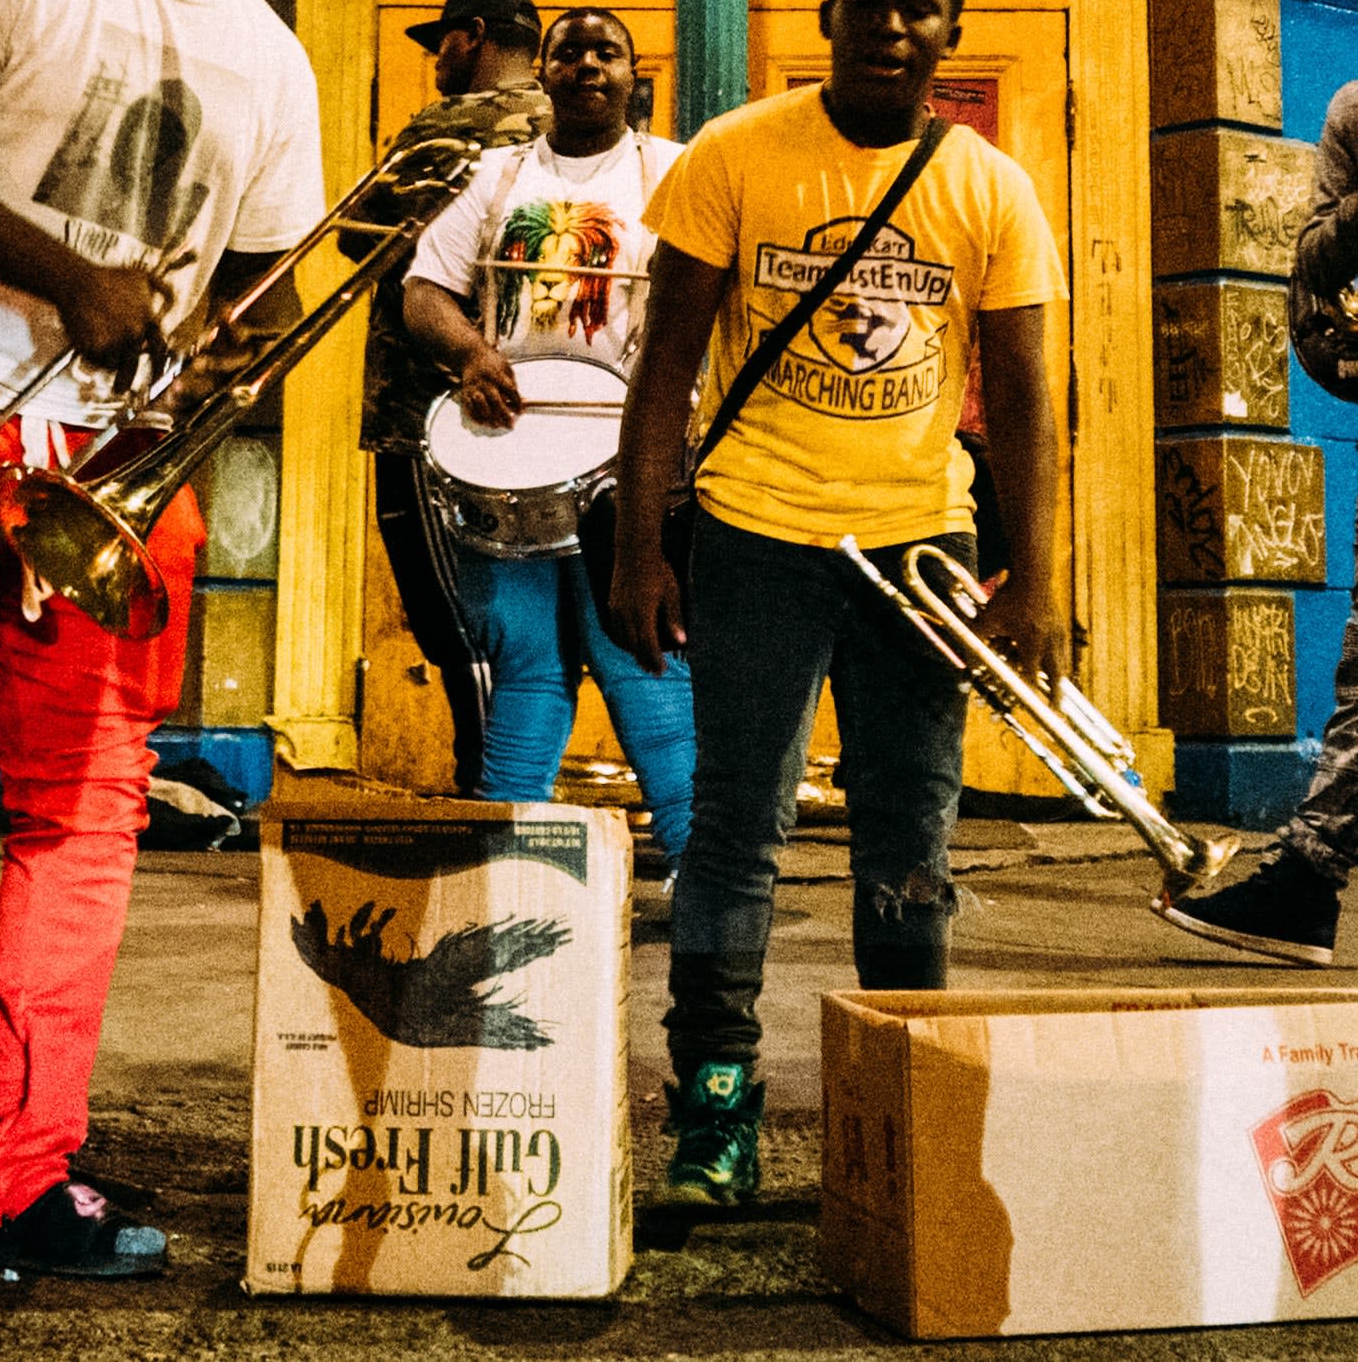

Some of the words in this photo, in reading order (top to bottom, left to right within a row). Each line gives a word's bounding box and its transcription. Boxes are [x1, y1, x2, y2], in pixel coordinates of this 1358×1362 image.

[766, 357, 875, 411] MARCHING
[881, 367, 935, 411] BAND
[1262, 1046, 1274, 1063] A
[1279, 1043, 1334, 1067] Family
[364, 1088, 456, 1118] SHRIMP
[462, 1091, 556, 1120] FROZEN
[292, 1124, 433, 1195] Fresh
[450, 1127, 562, 1197] Gulf
[297, 1199, 563, 1272] Louisiana
